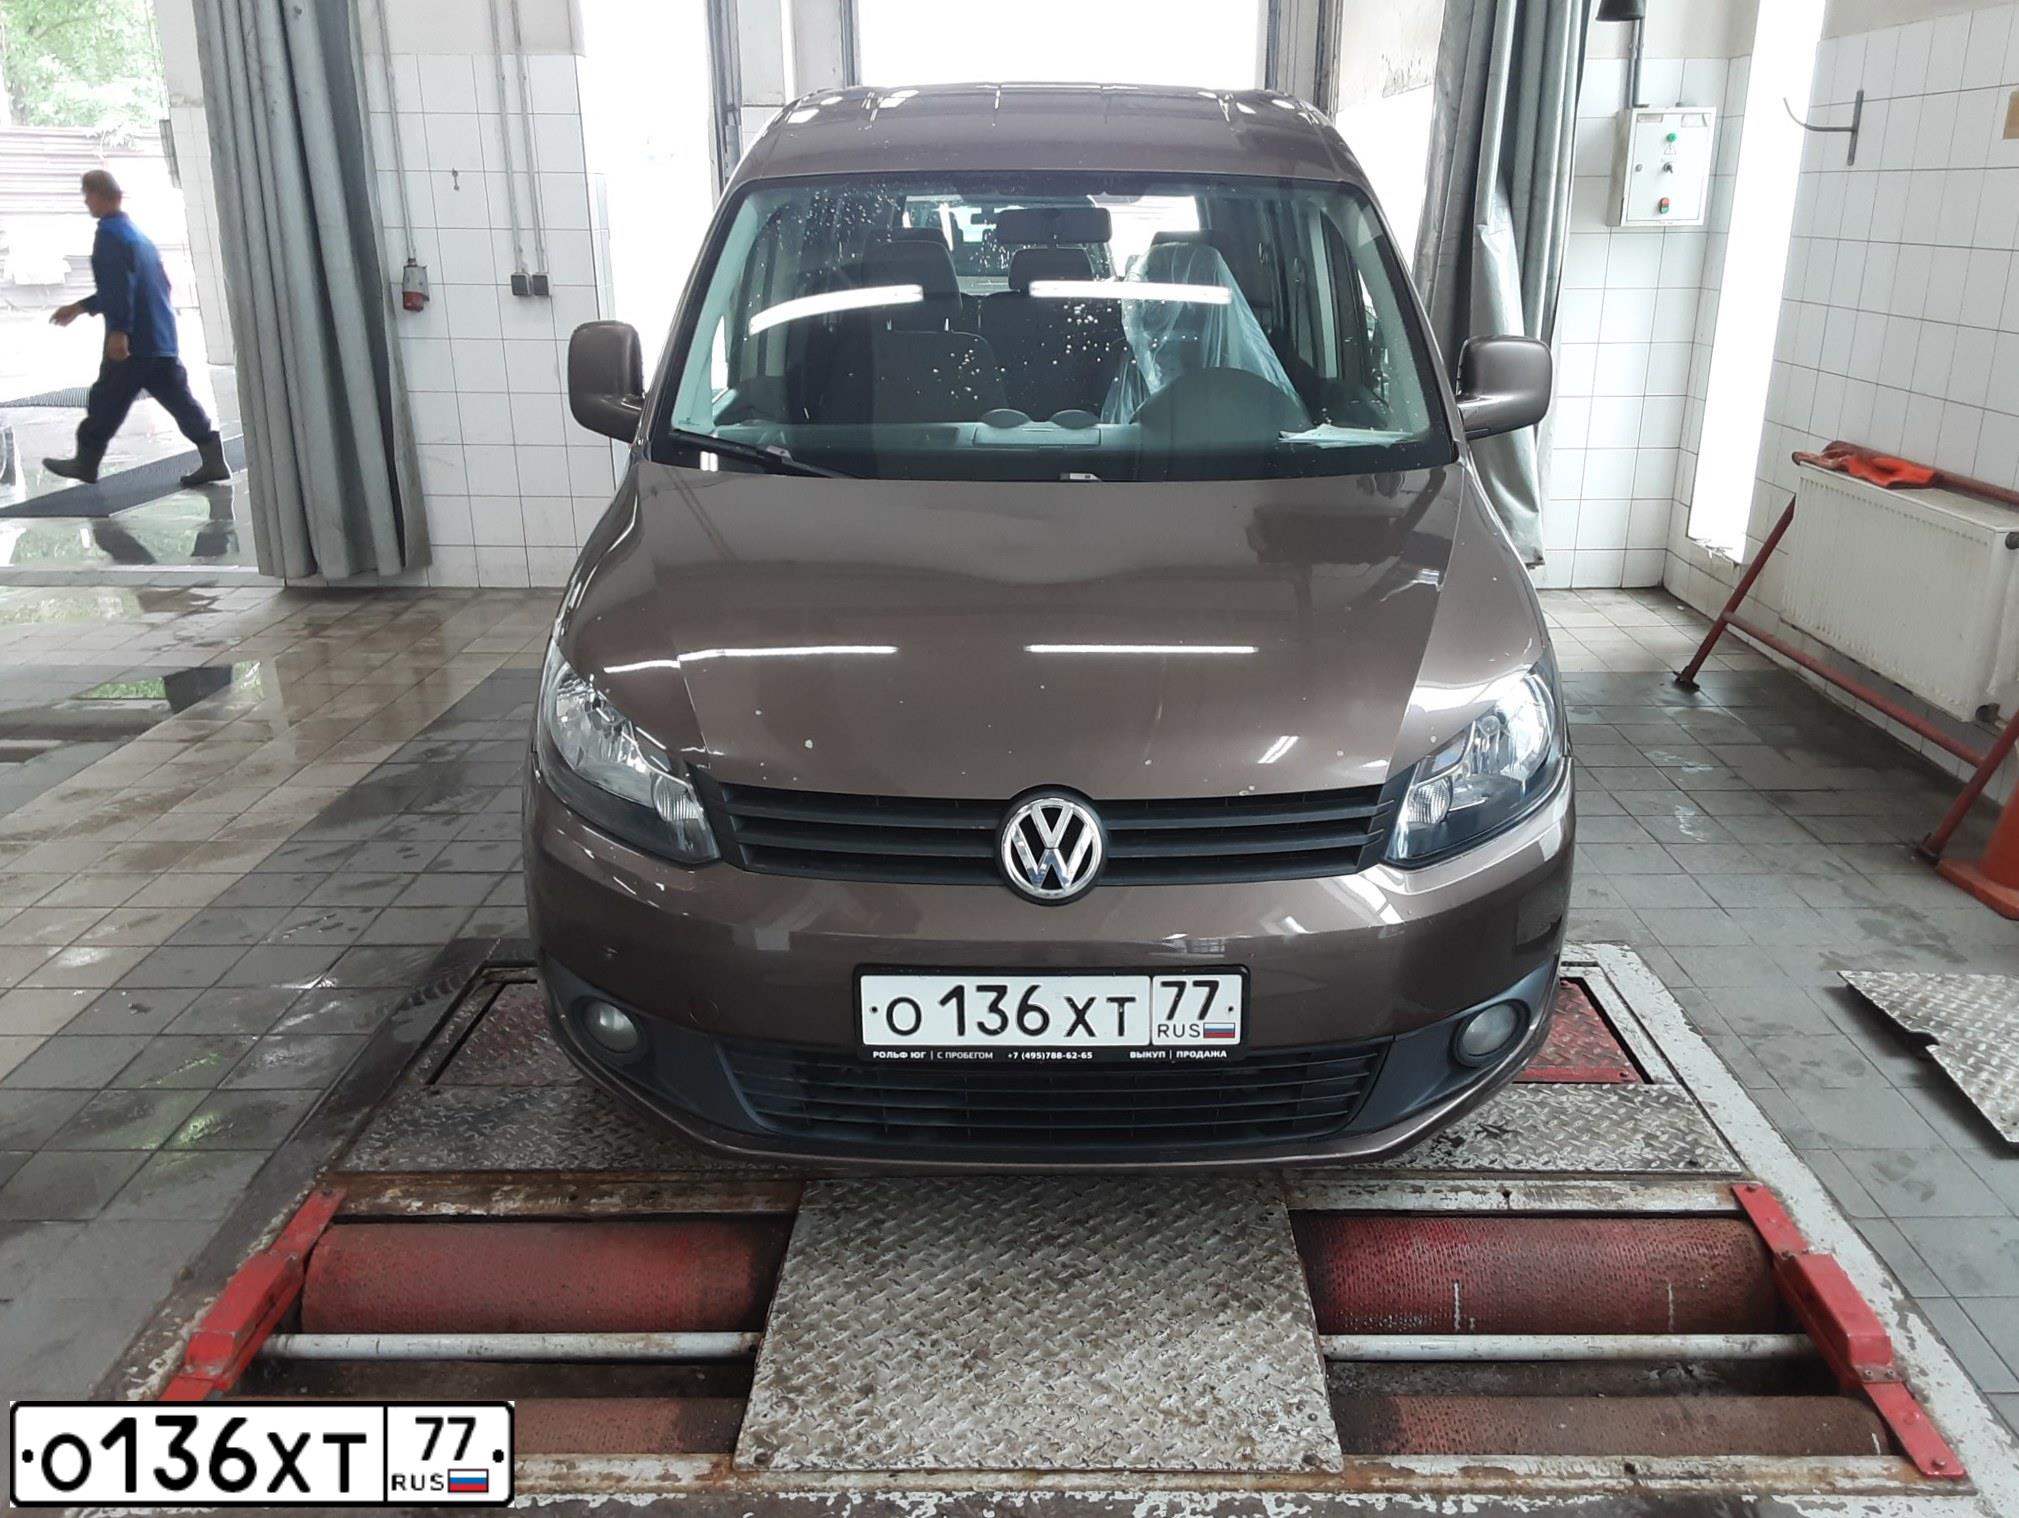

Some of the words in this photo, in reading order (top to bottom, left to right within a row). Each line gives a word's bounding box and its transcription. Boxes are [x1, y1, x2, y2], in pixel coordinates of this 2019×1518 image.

[1160, 980, 1220, 1021] 77
[1157, 1023, 1201, 1039] RUS
[872, 1050, 908, 1059] РОЛЬФ
[910, 1051, 927, 1059] ЮГ
[936, 1051, 943, 1059] С
[945, 1051, 993, 1060] ПРОБЕГОМ
[1007, 1051, 1019, 1060] +7
[1021, 1051, 1093, 1060] (495)788-62-65
[1129, 1050, 1166, 1059] ВЫКУП
[1176, 1050, 1228, 1060] ПРОДАЖА
